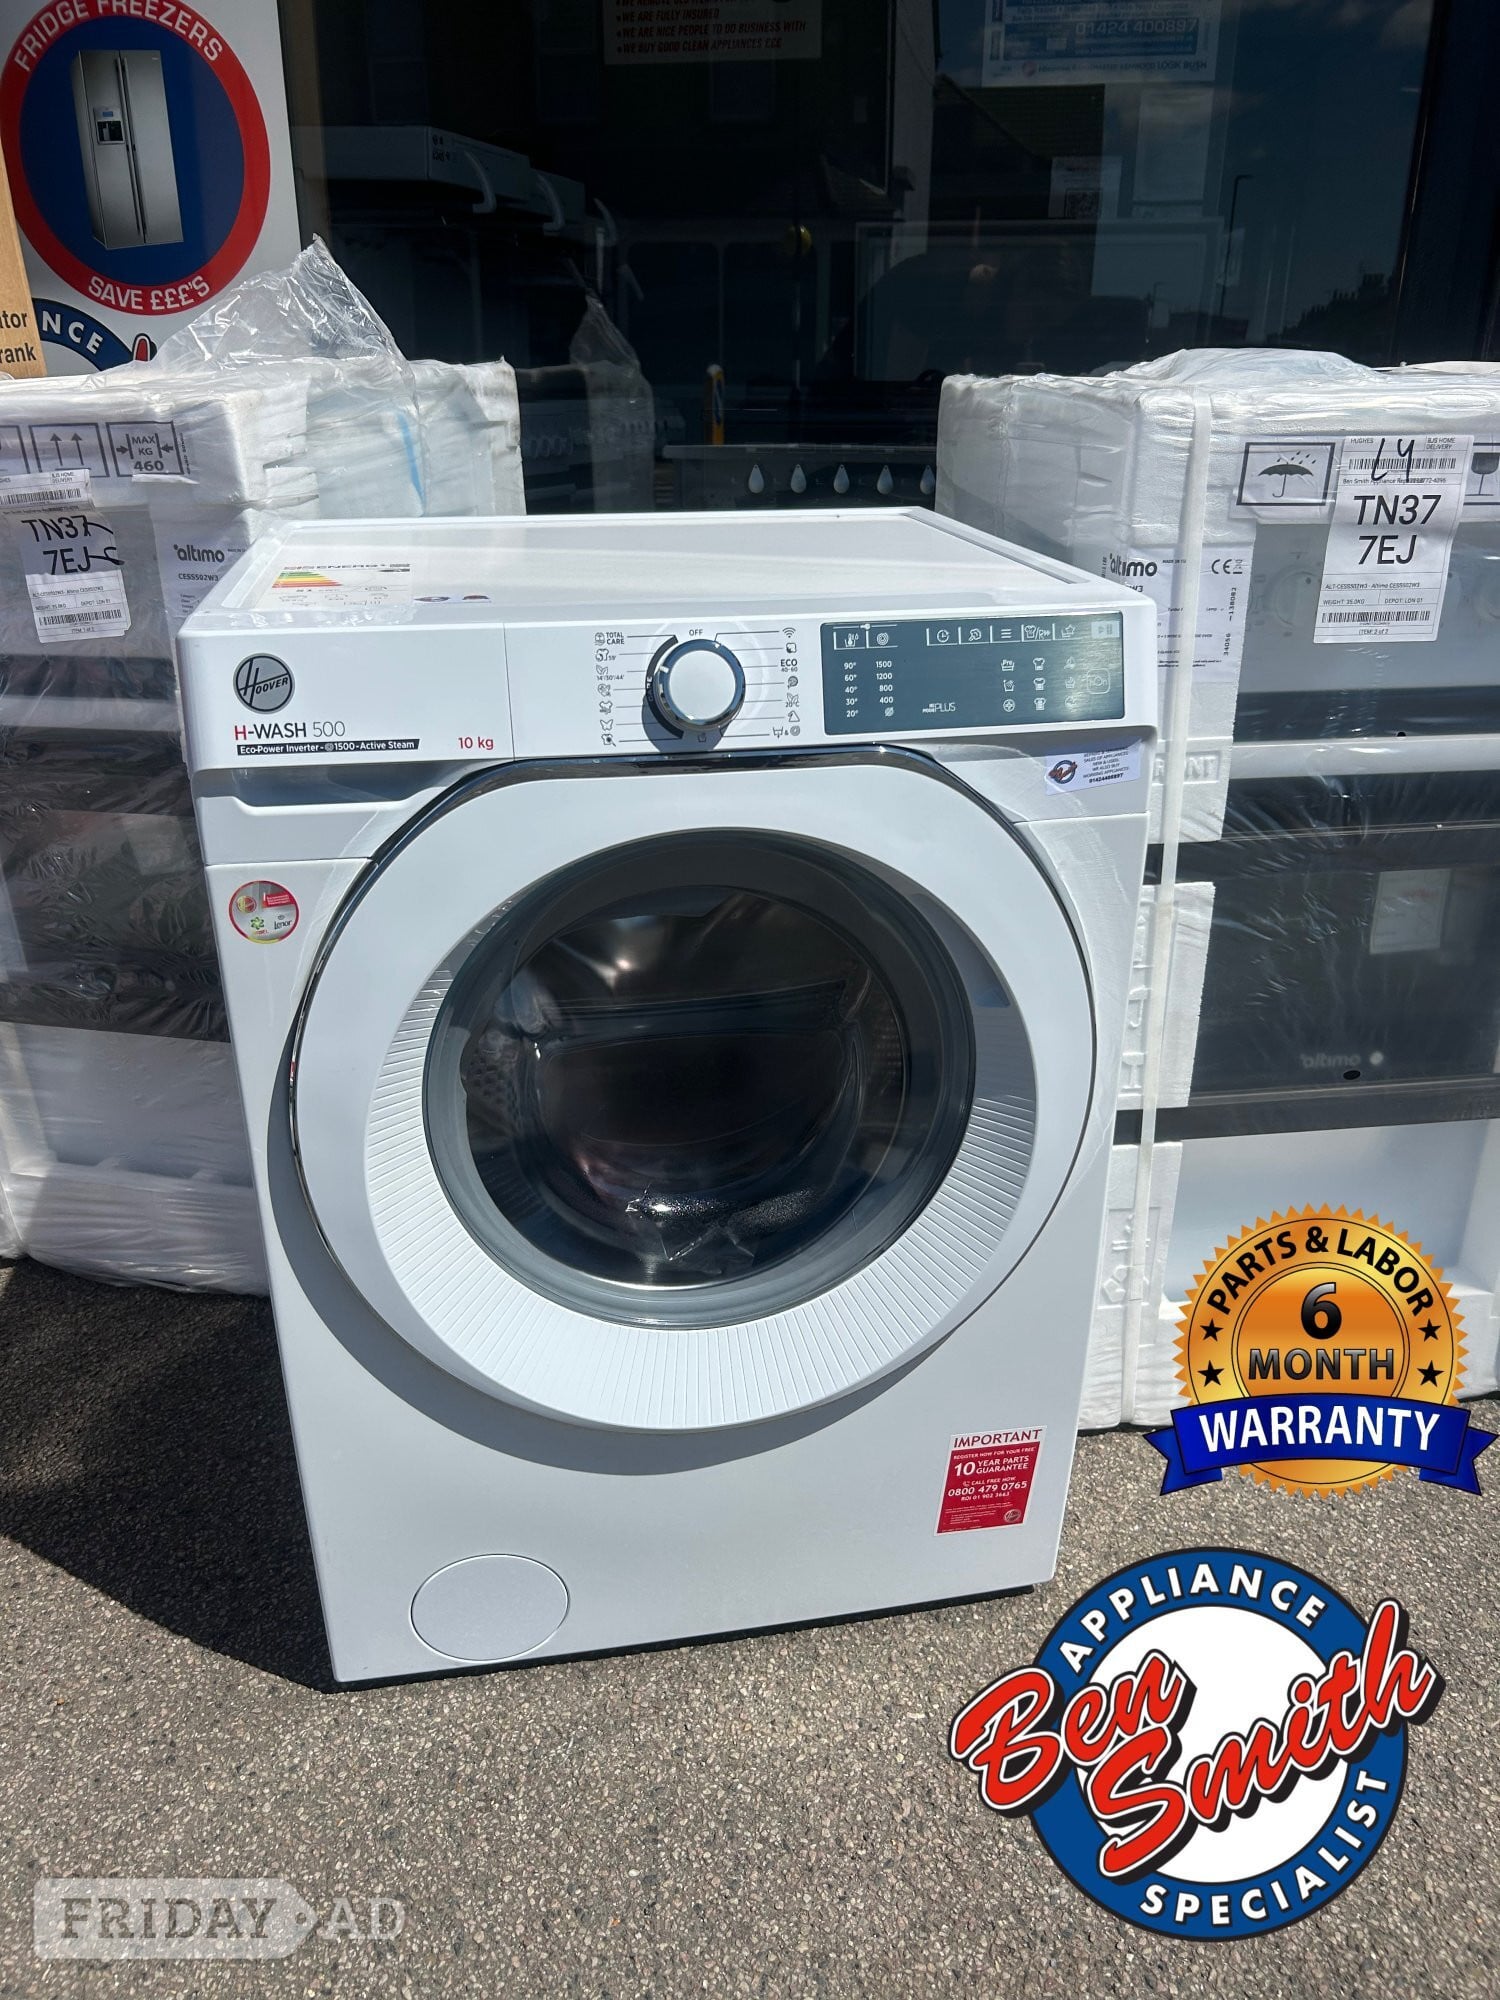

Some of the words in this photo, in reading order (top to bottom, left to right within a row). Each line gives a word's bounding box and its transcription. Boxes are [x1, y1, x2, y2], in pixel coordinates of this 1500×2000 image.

[738, 20, 780, 33] BUSINESS
[782, 18, 808, 32] WITH
[1075, 22, 1128, 34] 01424
[1133, 18, 1198, 33] 400897
[14, 0, 88, 72] FRIDGE
[98, 0, 223, 62] FREEZERS
[88, 276, 144, 311] SAVE
[151, 276, 210, 311] £££'S
[132, 436, 156, 444] MAX
[1438, 436, 1456, 444] HOME
[138, 447, 154, 456] KG
[134, 460, 164, 472] 460
[1354, 494, 1442, 526] TN37
[21, 515, 91, 542] TN37
[173, 544, 225, 563] altimo
[1358, 534, 1418, 565] 7EJ
[42, 546, 91, 576] 7EJ
[1110, 553, 1158, 577] altimo
[780, 658, 798, 667] ECO
[876, 660, 892, 668] 1500
[239, 657, 289, 706] HOOVER
[876, 672, 892, 680] 1200
[879, 684, 893, 692] 800
[879, 696, 894, 704] 400
[934, 702, 956, 712] PLUS
[234, 722, 307, 740] H-WASH
[312, 720, 346, 738] 500
[240, 744, 284, 754] Eco-Power
[286, 742, 318, 752] Inverter
[360, 742, 386, 750] Active
[387, 740, 414, 750] Steam
[458, 736, 474, 749] 10
[478, 736, 494, 750] kg
[274, 920, 292, 930] Lenor
[954, 1428, 1042, 1448] IMPORTANT
[953, 1452, 978, 1460] REGISTER
[954, 1462, 976, 1477] 10
[978, 1459, 1000, 1467] YEAR
[1002, 1455, 1030, 1464] PARTS
[976, 1462, 1028, 1474] GUARANTEE
[948, 1487, 974, 1497] 0800
[978, 1484, 998, 1493] 479
[1000, 1481, 1028, 1491] 0765
